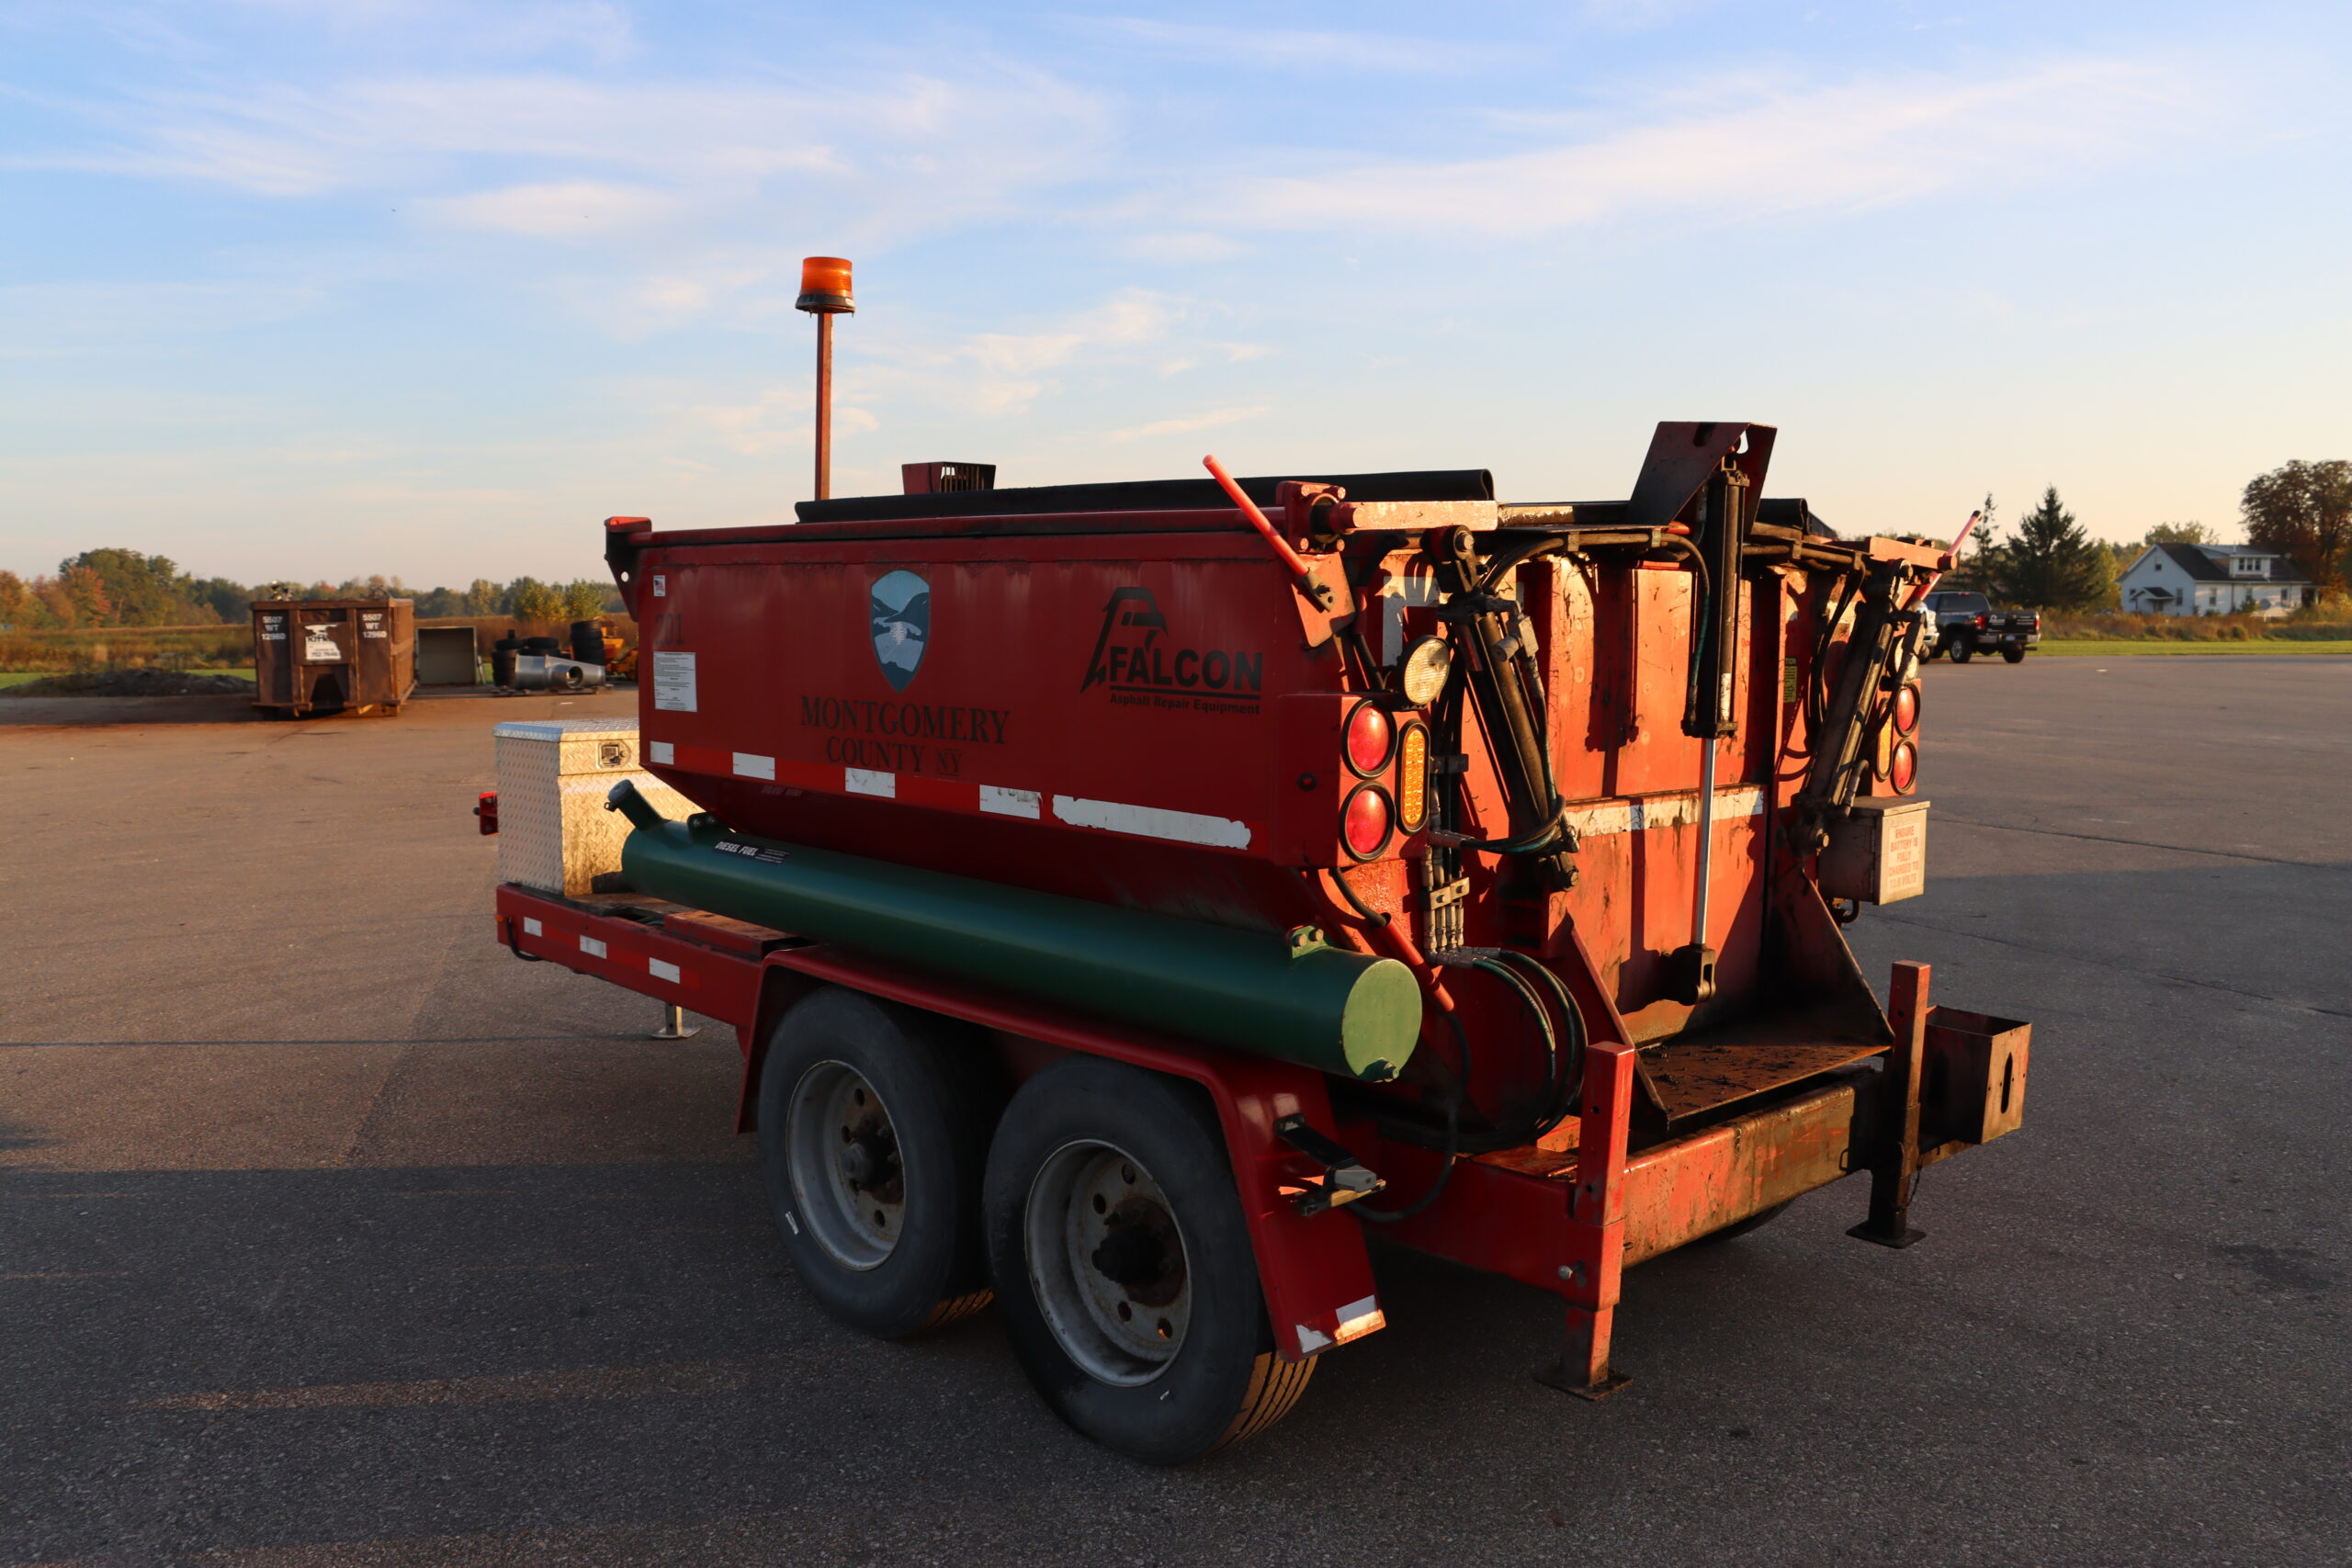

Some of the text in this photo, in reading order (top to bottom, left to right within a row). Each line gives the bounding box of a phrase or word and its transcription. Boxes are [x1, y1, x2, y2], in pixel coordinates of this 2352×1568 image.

[265, 624, 279, 632] WT
[365, 622, 379, 630] WT
[655, 614, 685, 645] 201
[1109, 645, 1263, 692] FALCON
[1110, 693, 1261, 716] Asphalt Repair Equipment
[799, 694, 1011, 745] MONTGOMERY
[826, 736, 963, 773] COUNTY NY
[715, 840, 741, 852] DIESEL
[738, 845, 759, 856] FUEL
[1890, 838, 1912, 852] BATTERY
[1897, 851, 1912, 863] FULLY
